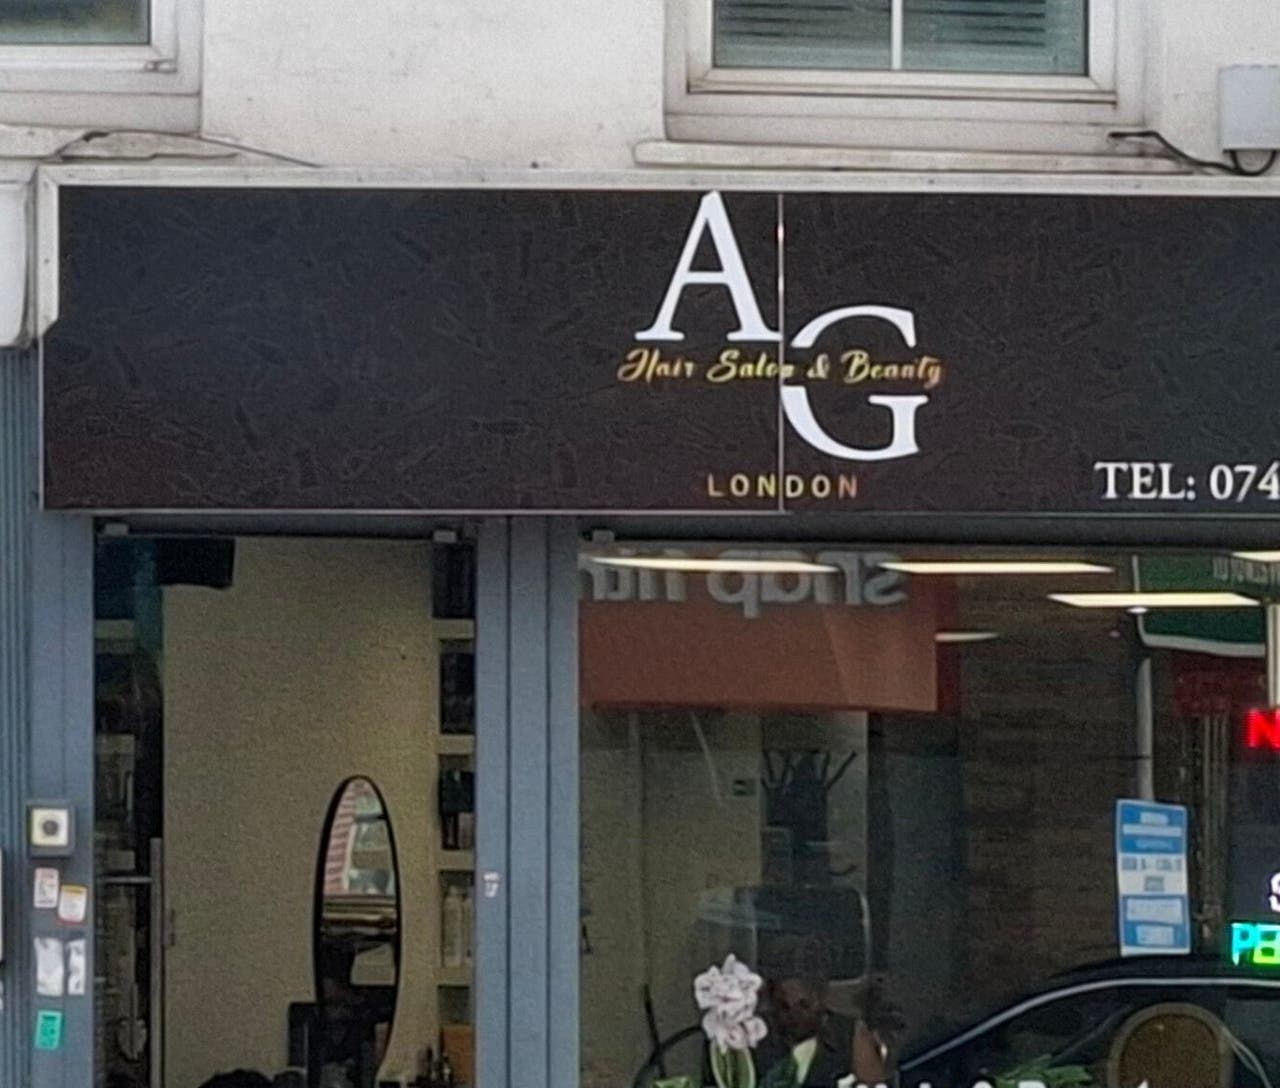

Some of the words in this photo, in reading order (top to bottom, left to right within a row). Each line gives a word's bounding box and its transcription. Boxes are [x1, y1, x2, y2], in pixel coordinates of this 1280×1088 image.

[617, 349, 695, 383] Hair
[706, 349, 795, 383] Salon
[806, 353, 830, 379] &
[841, 350, 942, 388] Beauty
[707, 474, 858, 497] LONDON
[1094, 461, 1196, 501] TEL:
